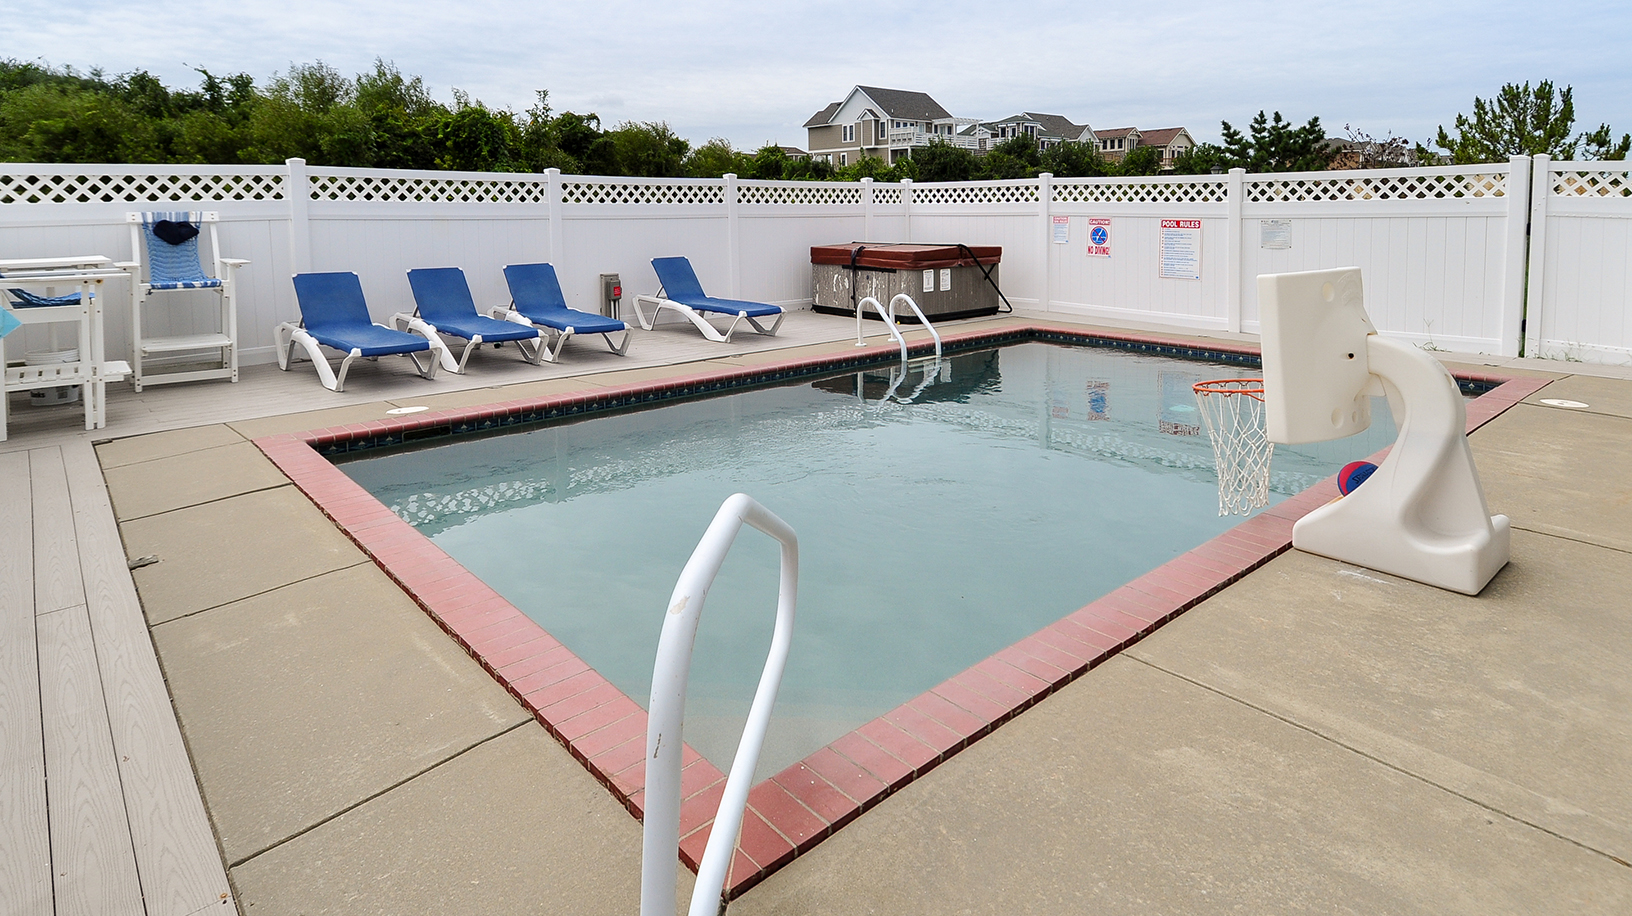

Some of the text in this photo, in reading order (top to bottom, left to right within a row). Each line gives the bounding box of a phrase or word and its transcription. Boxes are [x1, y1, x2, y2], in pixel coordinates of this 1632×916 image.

[1162, 220, 1200, 228] POOL RULES
[1088, 245, 1094, 254] NO
